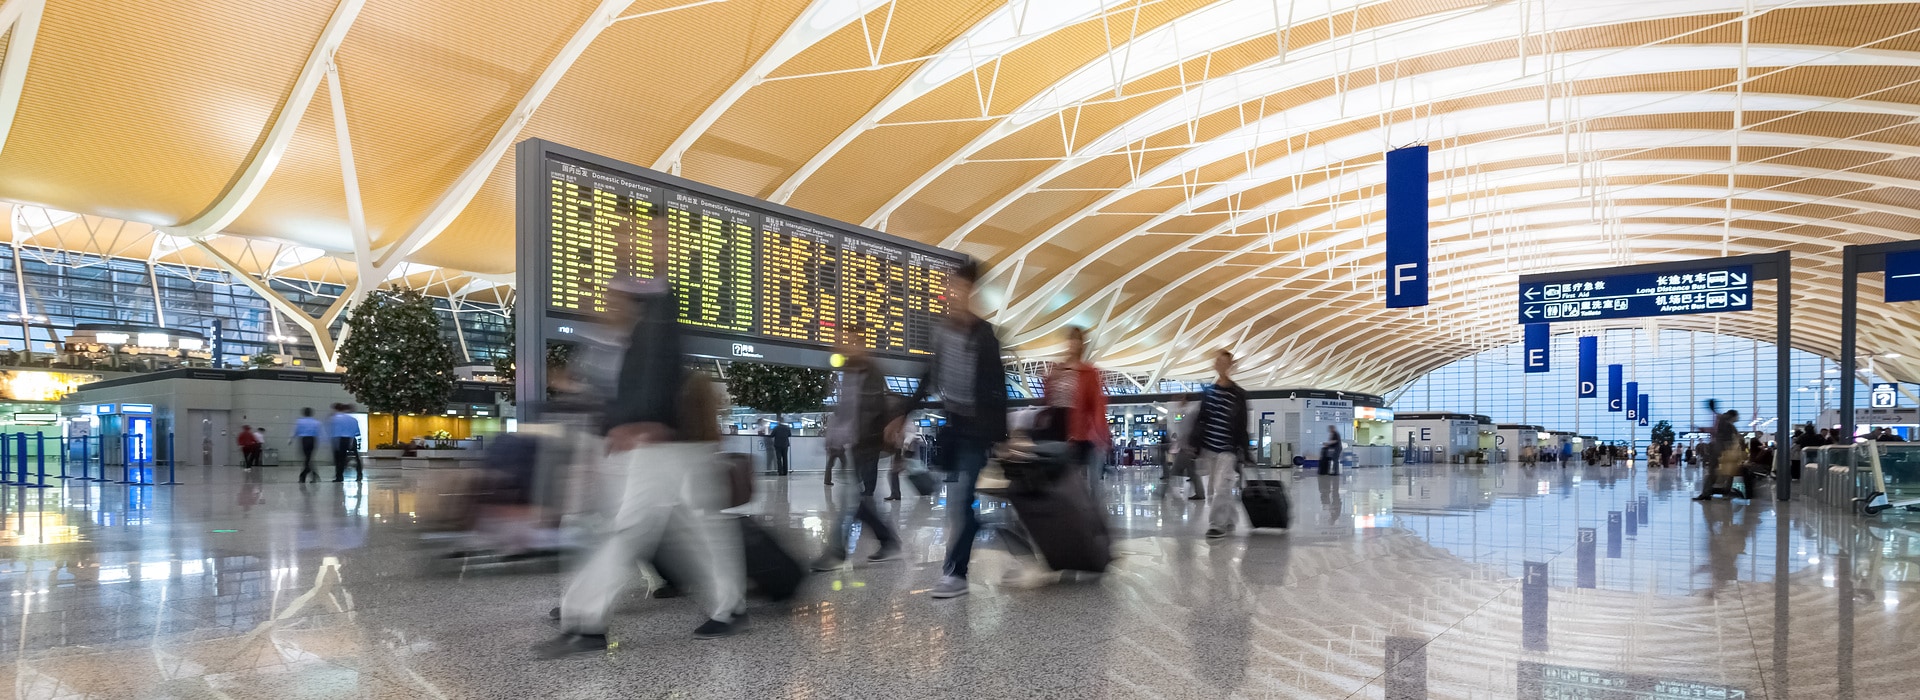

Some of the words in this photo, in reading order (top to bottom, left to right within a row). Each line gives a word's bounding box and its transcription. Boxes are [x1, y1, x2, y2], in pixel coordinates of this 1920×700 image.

[562, 164, 588, 178] 国内出发
[592, 172, 620, 184] Domestic
[620, 180, 652, 192] Departures
[701, 200, 723, 210] Domestic
[724, 206, 750, 217] Departures
[785, 220, 812, 232] International
[812, 228, 834, 238] Departures
[1394, 262, 1417, 296] F
[1656, 272, 1706, 286] 长途汽车
[1562, 281, 1606, 292] 医疗急救
[1657, 284, 1690, 293] Distance
[1655, 293, 1706, 306] 机场巴士
[1660, 304, 1690, 312] Airport
[1530, 348, 1544, 366] E
[1582, 382, 1594, 394] D
[1610, 399, 1620, 409] C
[1628, 410, 1636, 418] B
[1421, 428, 1431, 441] E
